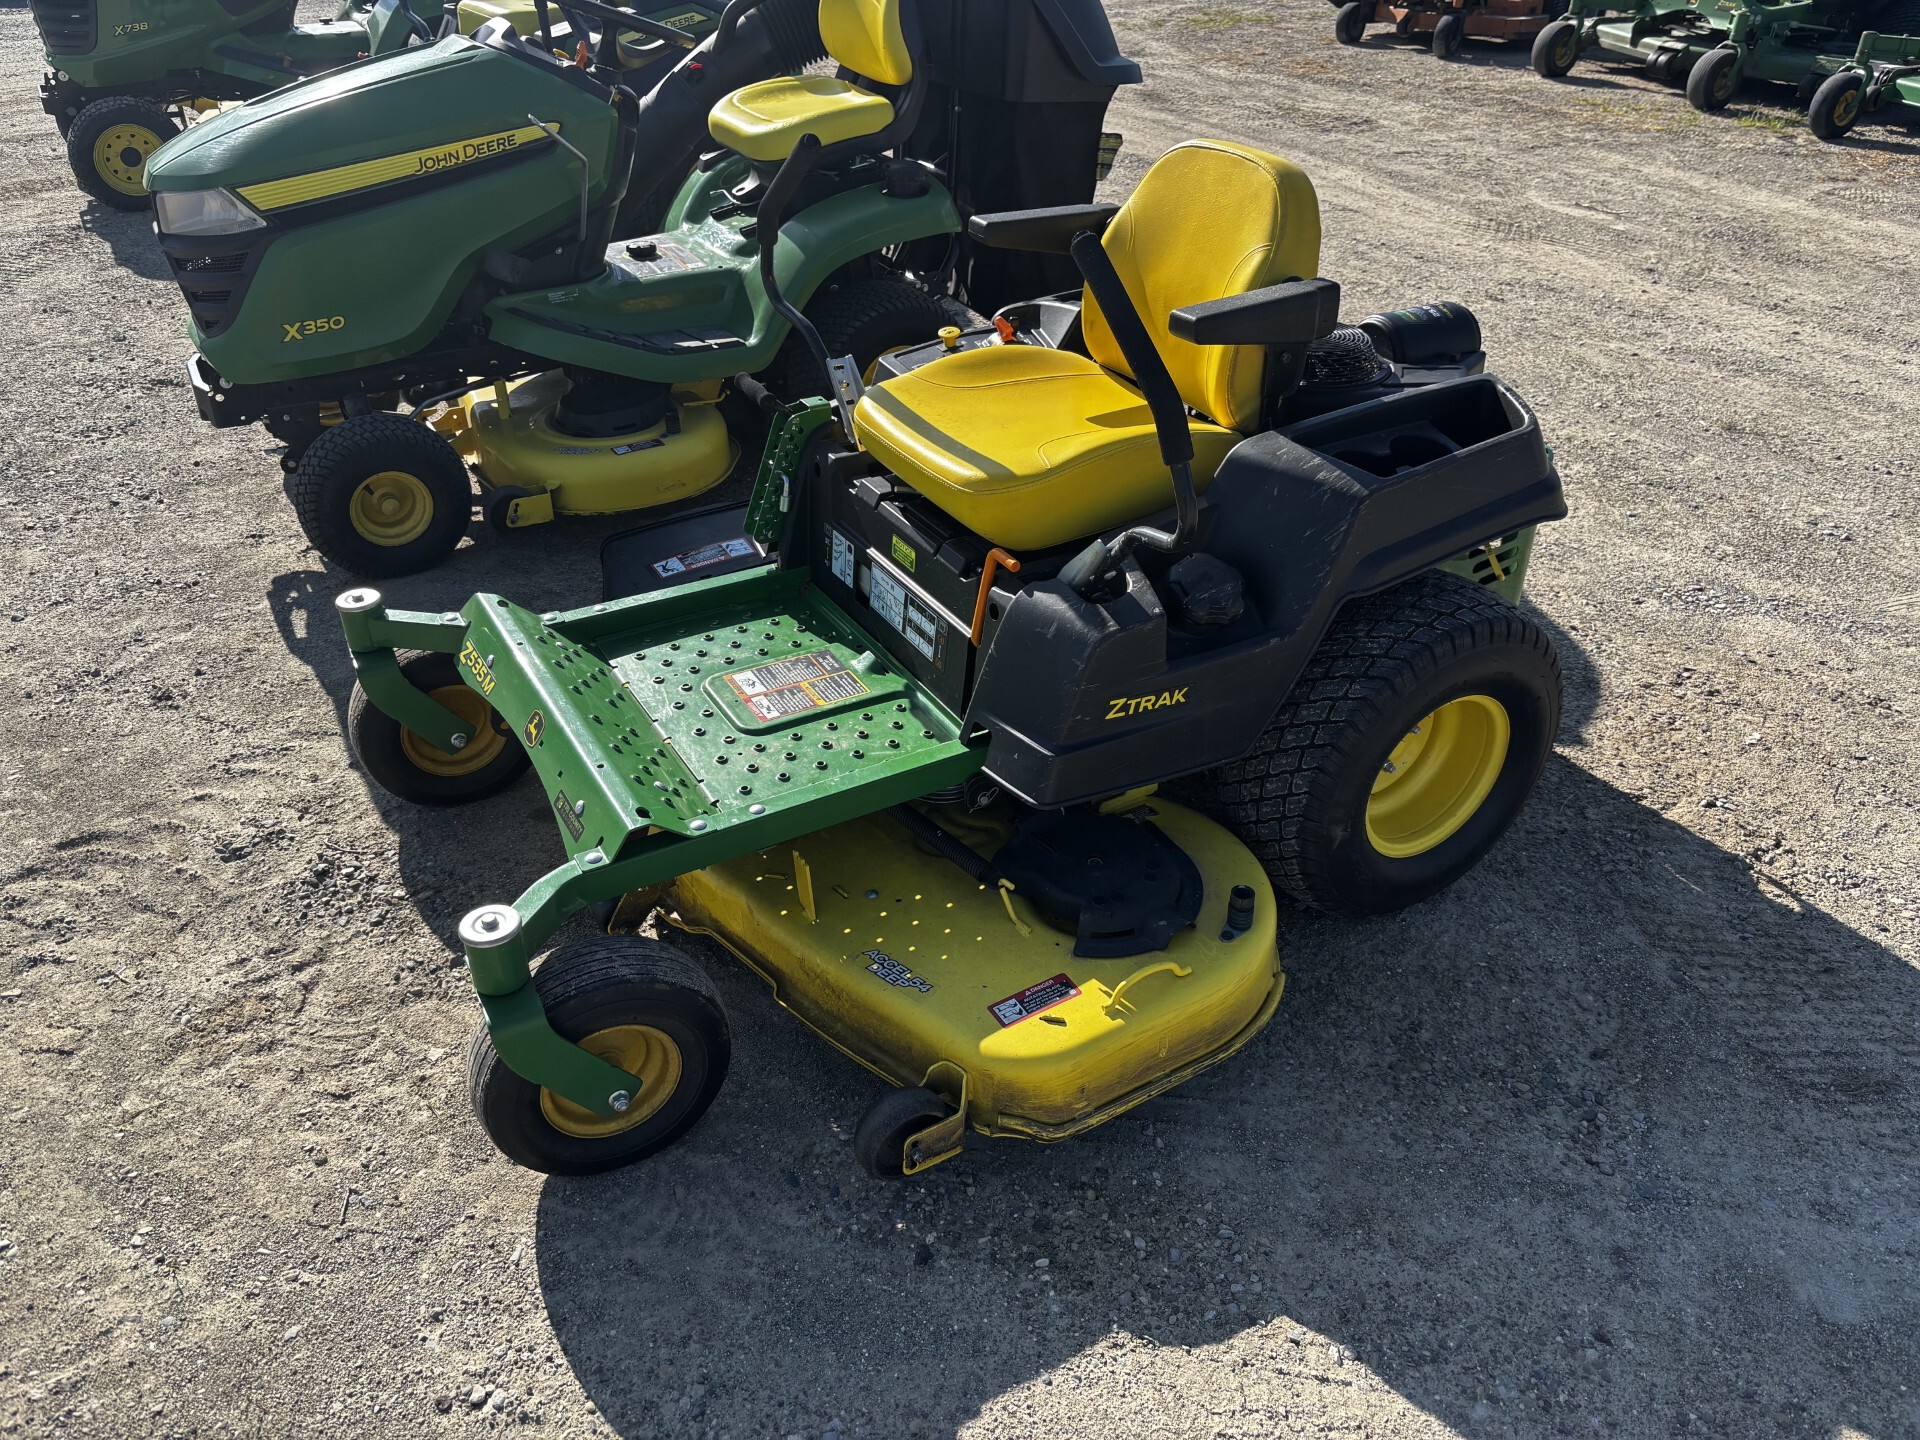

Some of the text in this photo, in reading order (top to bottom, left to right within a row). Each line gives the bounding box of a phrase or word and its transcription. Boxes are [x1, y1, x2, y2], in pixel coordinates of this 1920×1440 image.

[114, 22, 149, 36] X738
[665, 15, 697, 29] DEERE
[415, 134, 518, 174] JOHN DEERE
[282, 315, 345, 342] X350
[690, 557, 719, 569] DANGER
[458, 640, 496, 696] Z535M
[1105, 687, 1189, 720] ZTRAK
[862, 949, 934, 993] ACCEL 54
[865, 962, 910, 987] DEEP
[1030, 979, 1055, 993] DANGER
